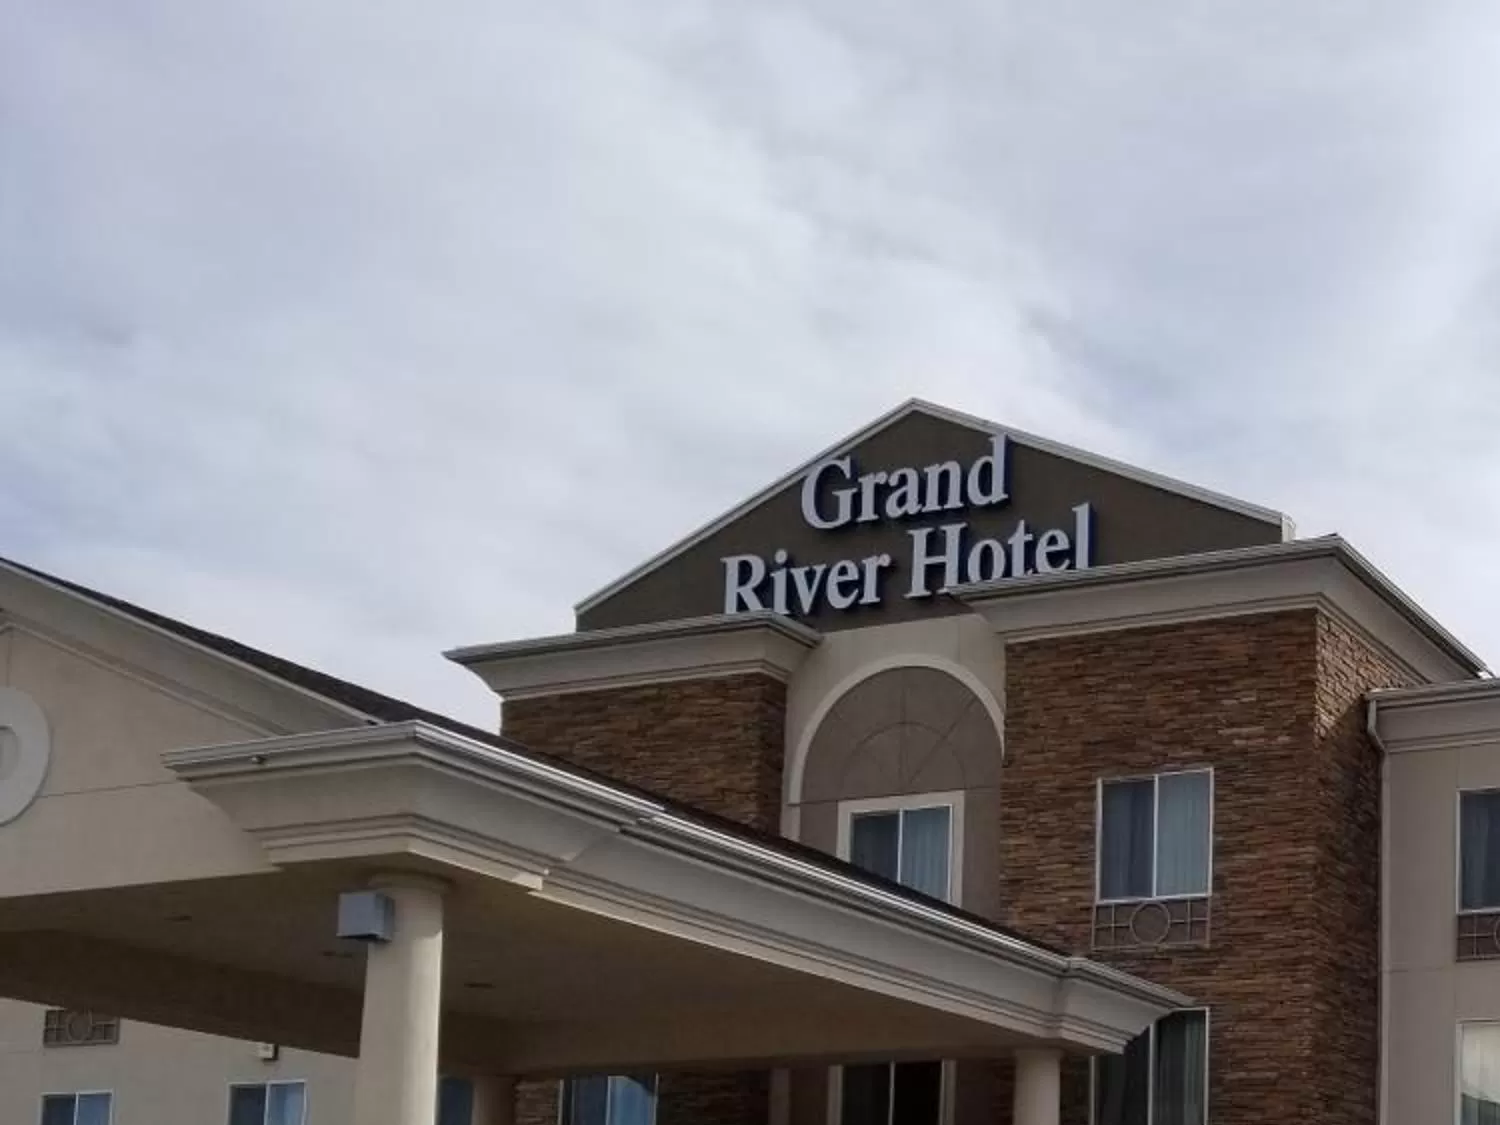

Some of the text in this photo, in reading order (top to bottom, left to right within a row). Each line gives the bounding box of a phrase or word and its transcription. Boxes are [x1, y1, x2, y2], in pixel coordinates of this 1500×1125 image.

[801, 433, 1009, 530] Grand
[720, 502, 1092, 616] River Hotel
